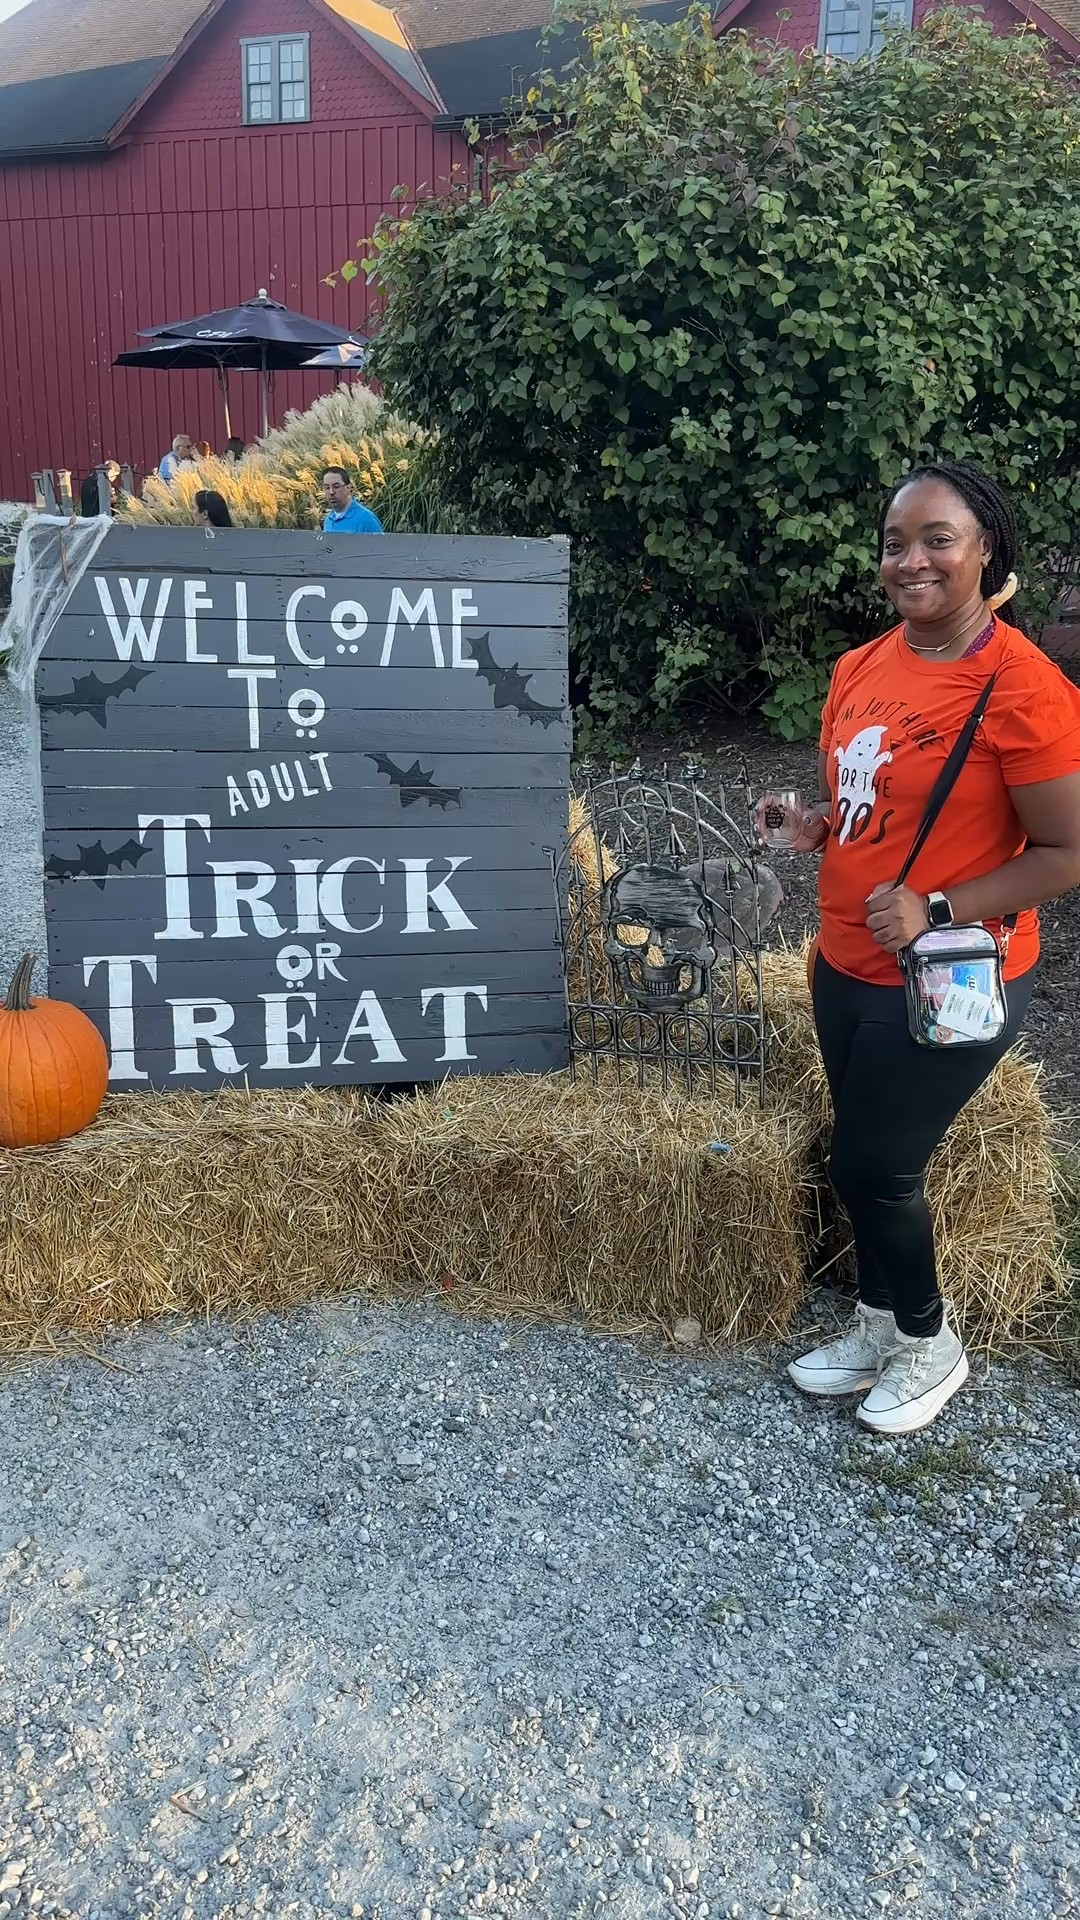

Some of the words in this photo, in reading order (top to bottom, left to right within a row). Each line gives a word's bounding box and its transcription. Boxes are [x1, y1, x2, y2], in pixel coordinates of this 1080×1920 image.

[94, 576, 480, 669] WELCOME
[227, 668, 326, 749] TO
[857, 697, 907, 721] JUST
[226, 752, 335, 816] ADULT
[862, 771, 893, 798] THE
[137, 813, 479, 940] TRICK
[275, 942, 348, 988] OR
[82, 954, 488, 1081] TREAT
